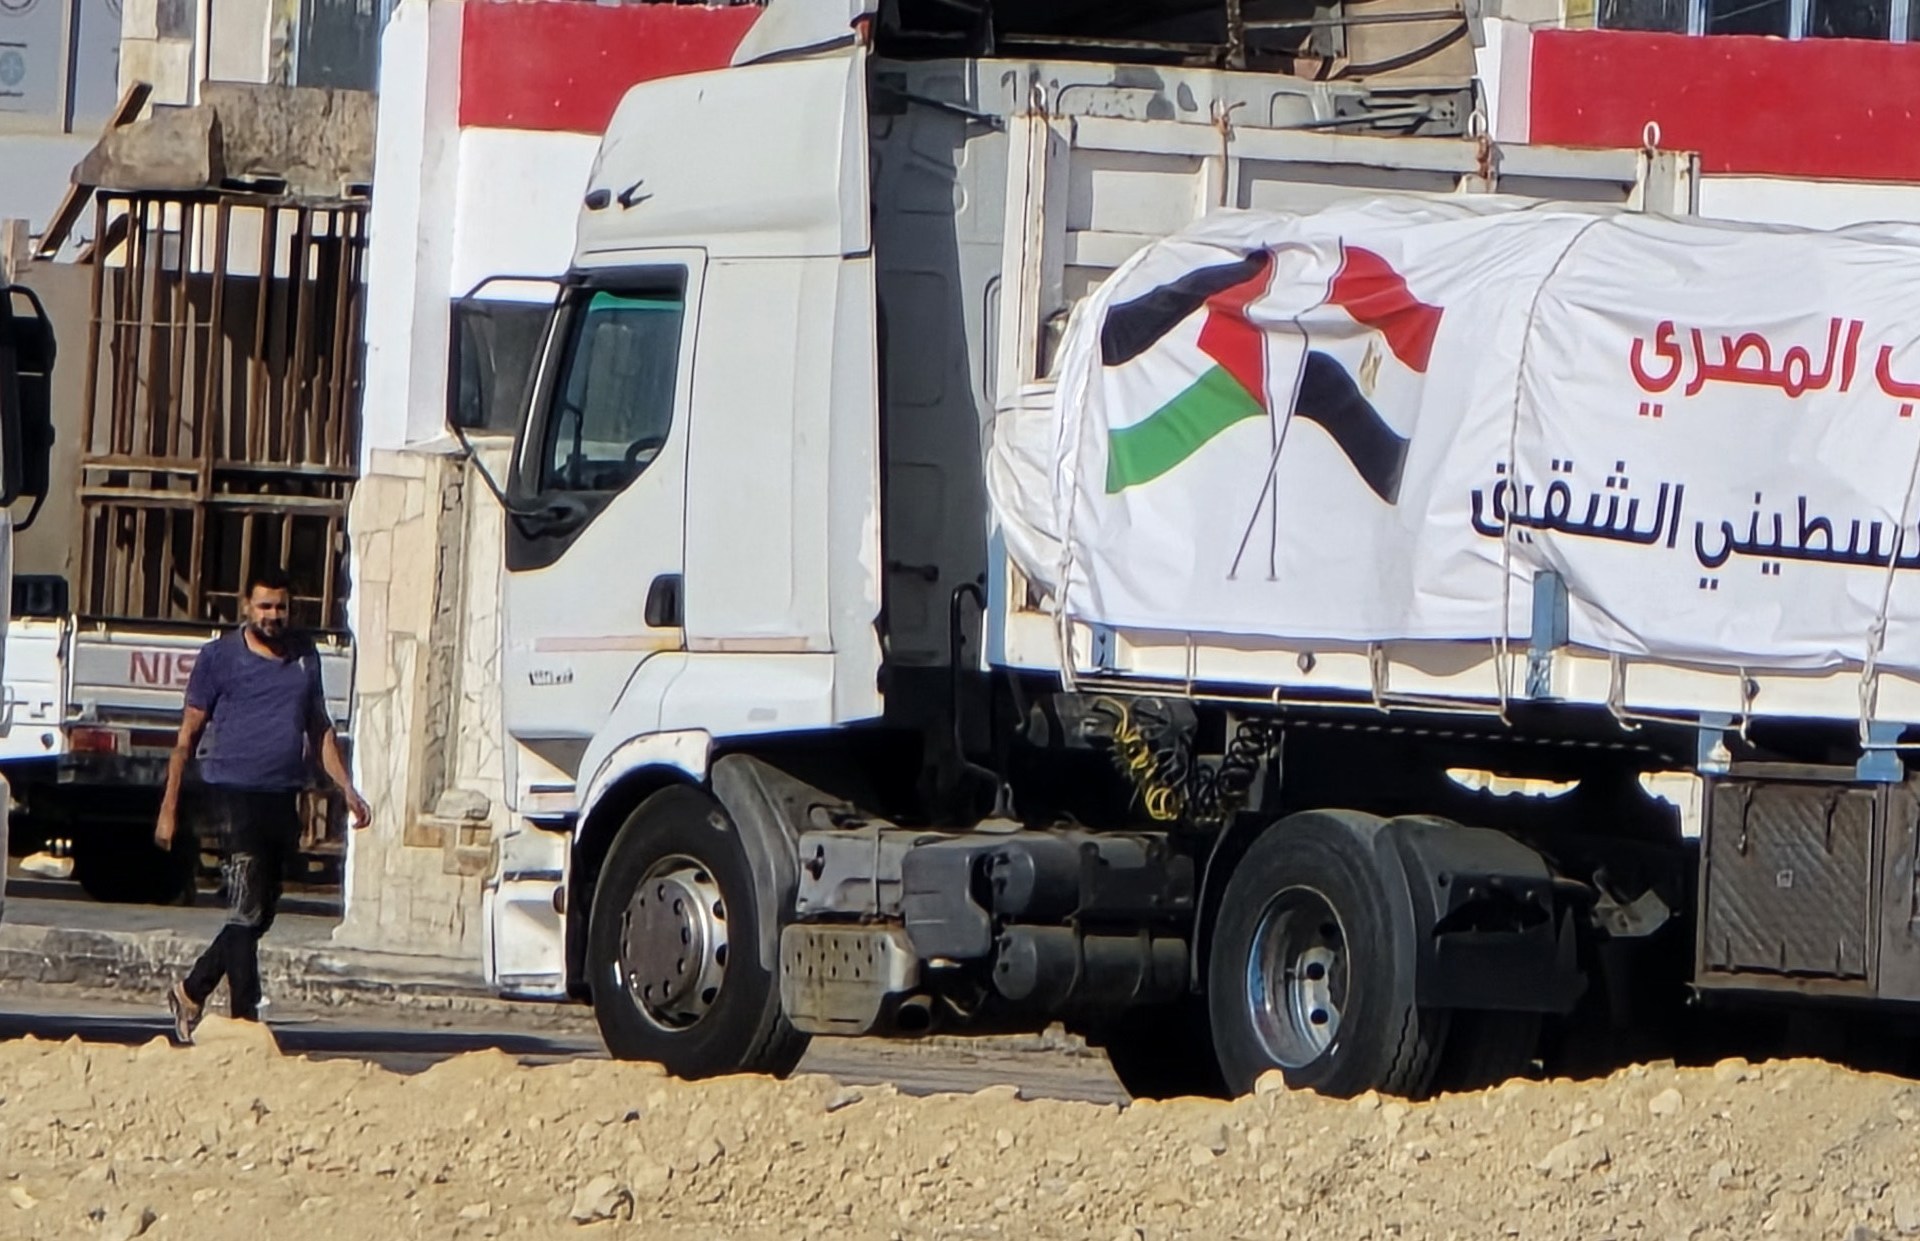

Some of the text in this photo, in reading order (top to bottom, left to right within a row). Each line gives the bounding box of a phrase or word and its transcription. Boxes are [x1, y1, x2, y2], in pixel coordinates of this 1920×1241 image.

[1630, 317, 1864, 417] المصري
[1471, 459, 1920, 590] سطيني الشقيق
[129, 651, 198, 686] NIS
